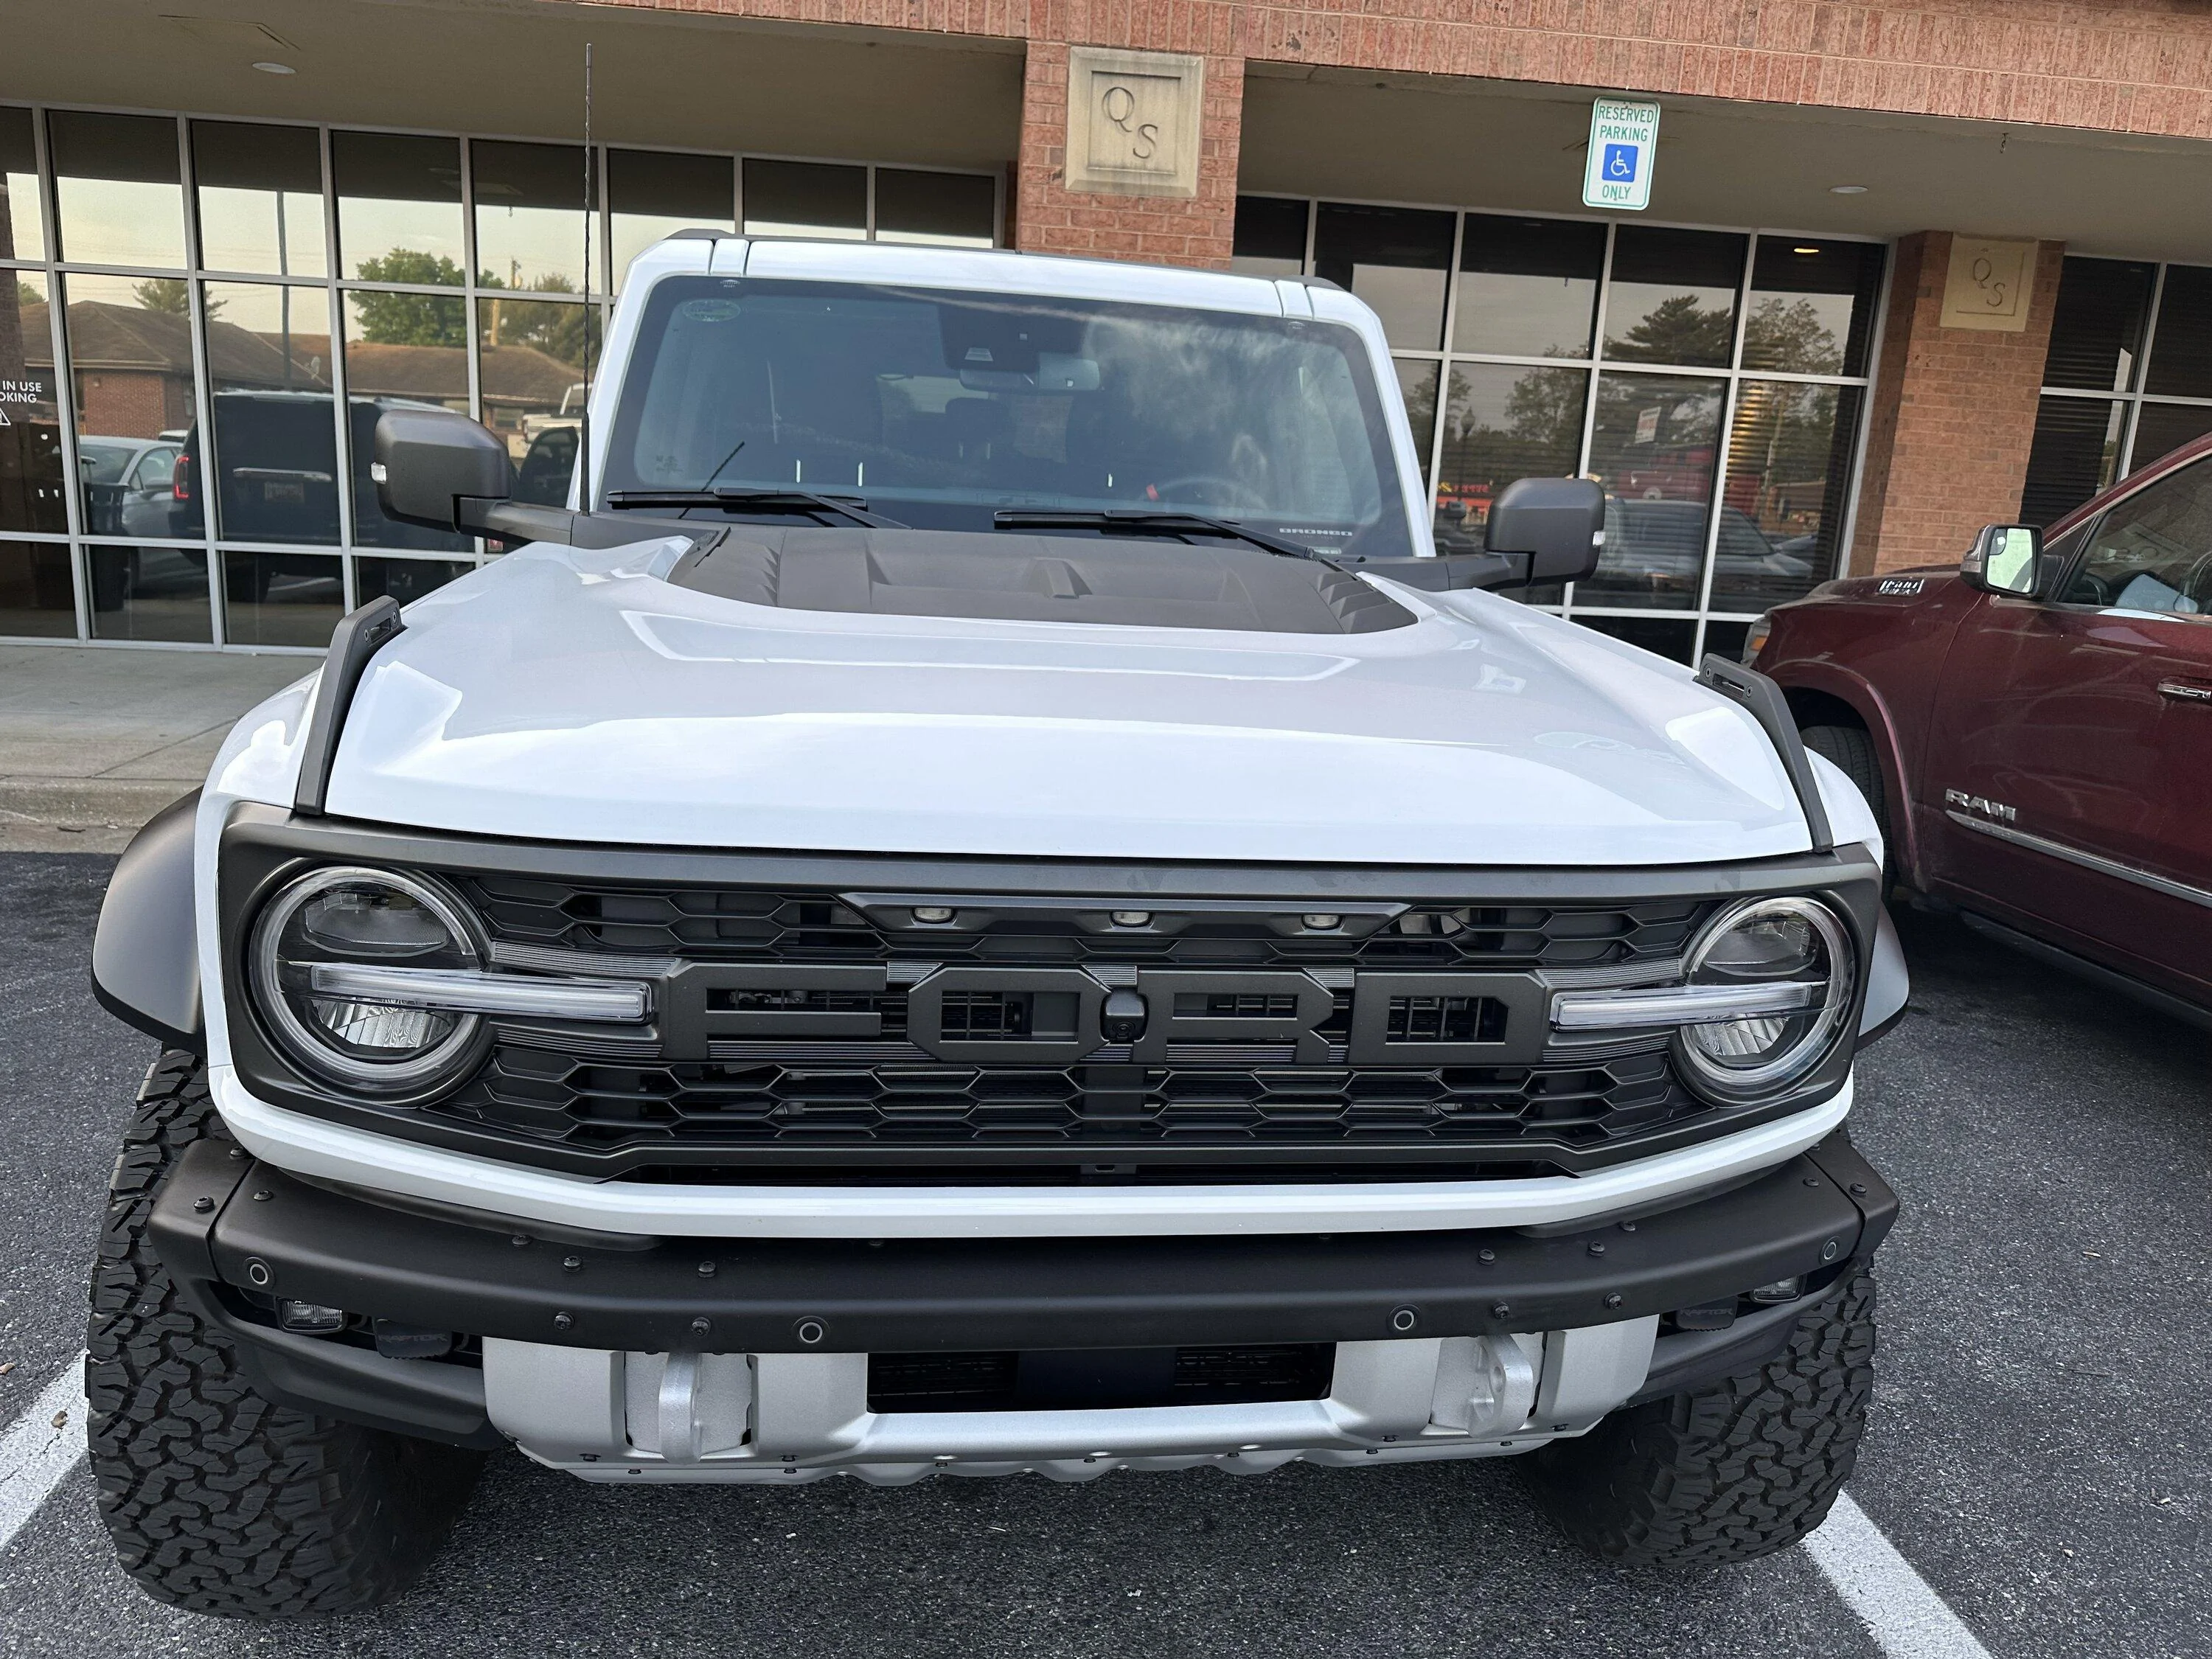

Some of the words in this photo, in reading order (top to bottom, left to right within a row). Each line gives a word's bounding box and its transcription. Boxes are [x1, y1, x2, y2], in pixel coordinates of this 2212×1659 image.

[1598, 105, 1654, 123] RESERVED
[1600, 125, 1648, 142] PARKING
[1602, 185, 1631, 200] ONLY
[2, 380, 15, 391] IN
[20, 381, 42, 392] USE
[1945, 788, 2016, 821] RAM
[666, 961, 1547, 1065] FORD
[1680, 1308, 1733, 1316] RAPTOR
[378, 1333, 448, 1342] RAPTOR
